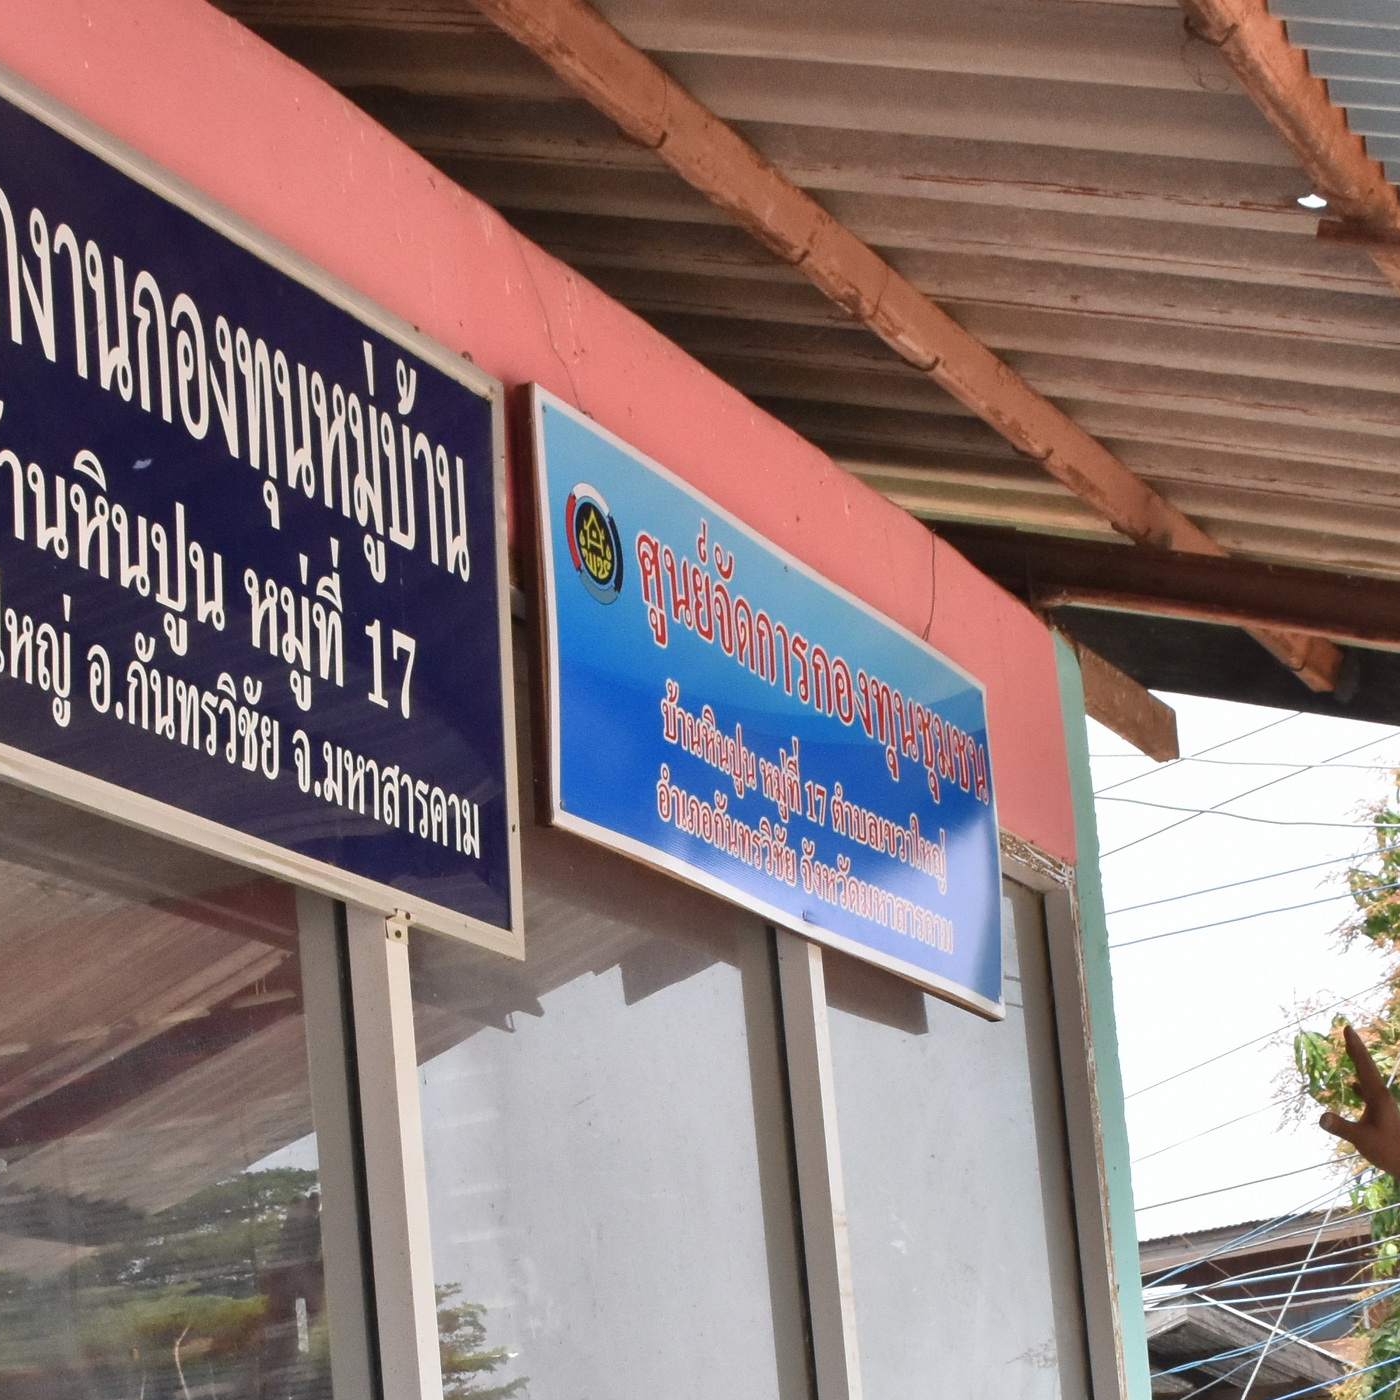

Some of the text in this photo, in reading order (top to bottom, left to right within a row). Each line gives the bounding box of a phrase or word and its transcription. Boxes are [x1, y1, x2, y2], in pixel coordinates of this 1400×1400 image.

[244, 537, 346, 712] หมู่ที่
[365, 618, 417, 720] 17
[635, 520, 990, 805] ศูนย์จัดการกองทุนชุมชน
[88, 633, 282, 780] อ.กันทรวิชัย
[292, 727, 482, 861] จ.มหาสารคาม
[660, 678, 947, 895] บ้านหินปูน หมู่ที่ 17 ตำบลเขวาใหญ่
[656, 763, 955, 955] อำเภอกันทรวิชัย จังหวัดมหาสารคาม
